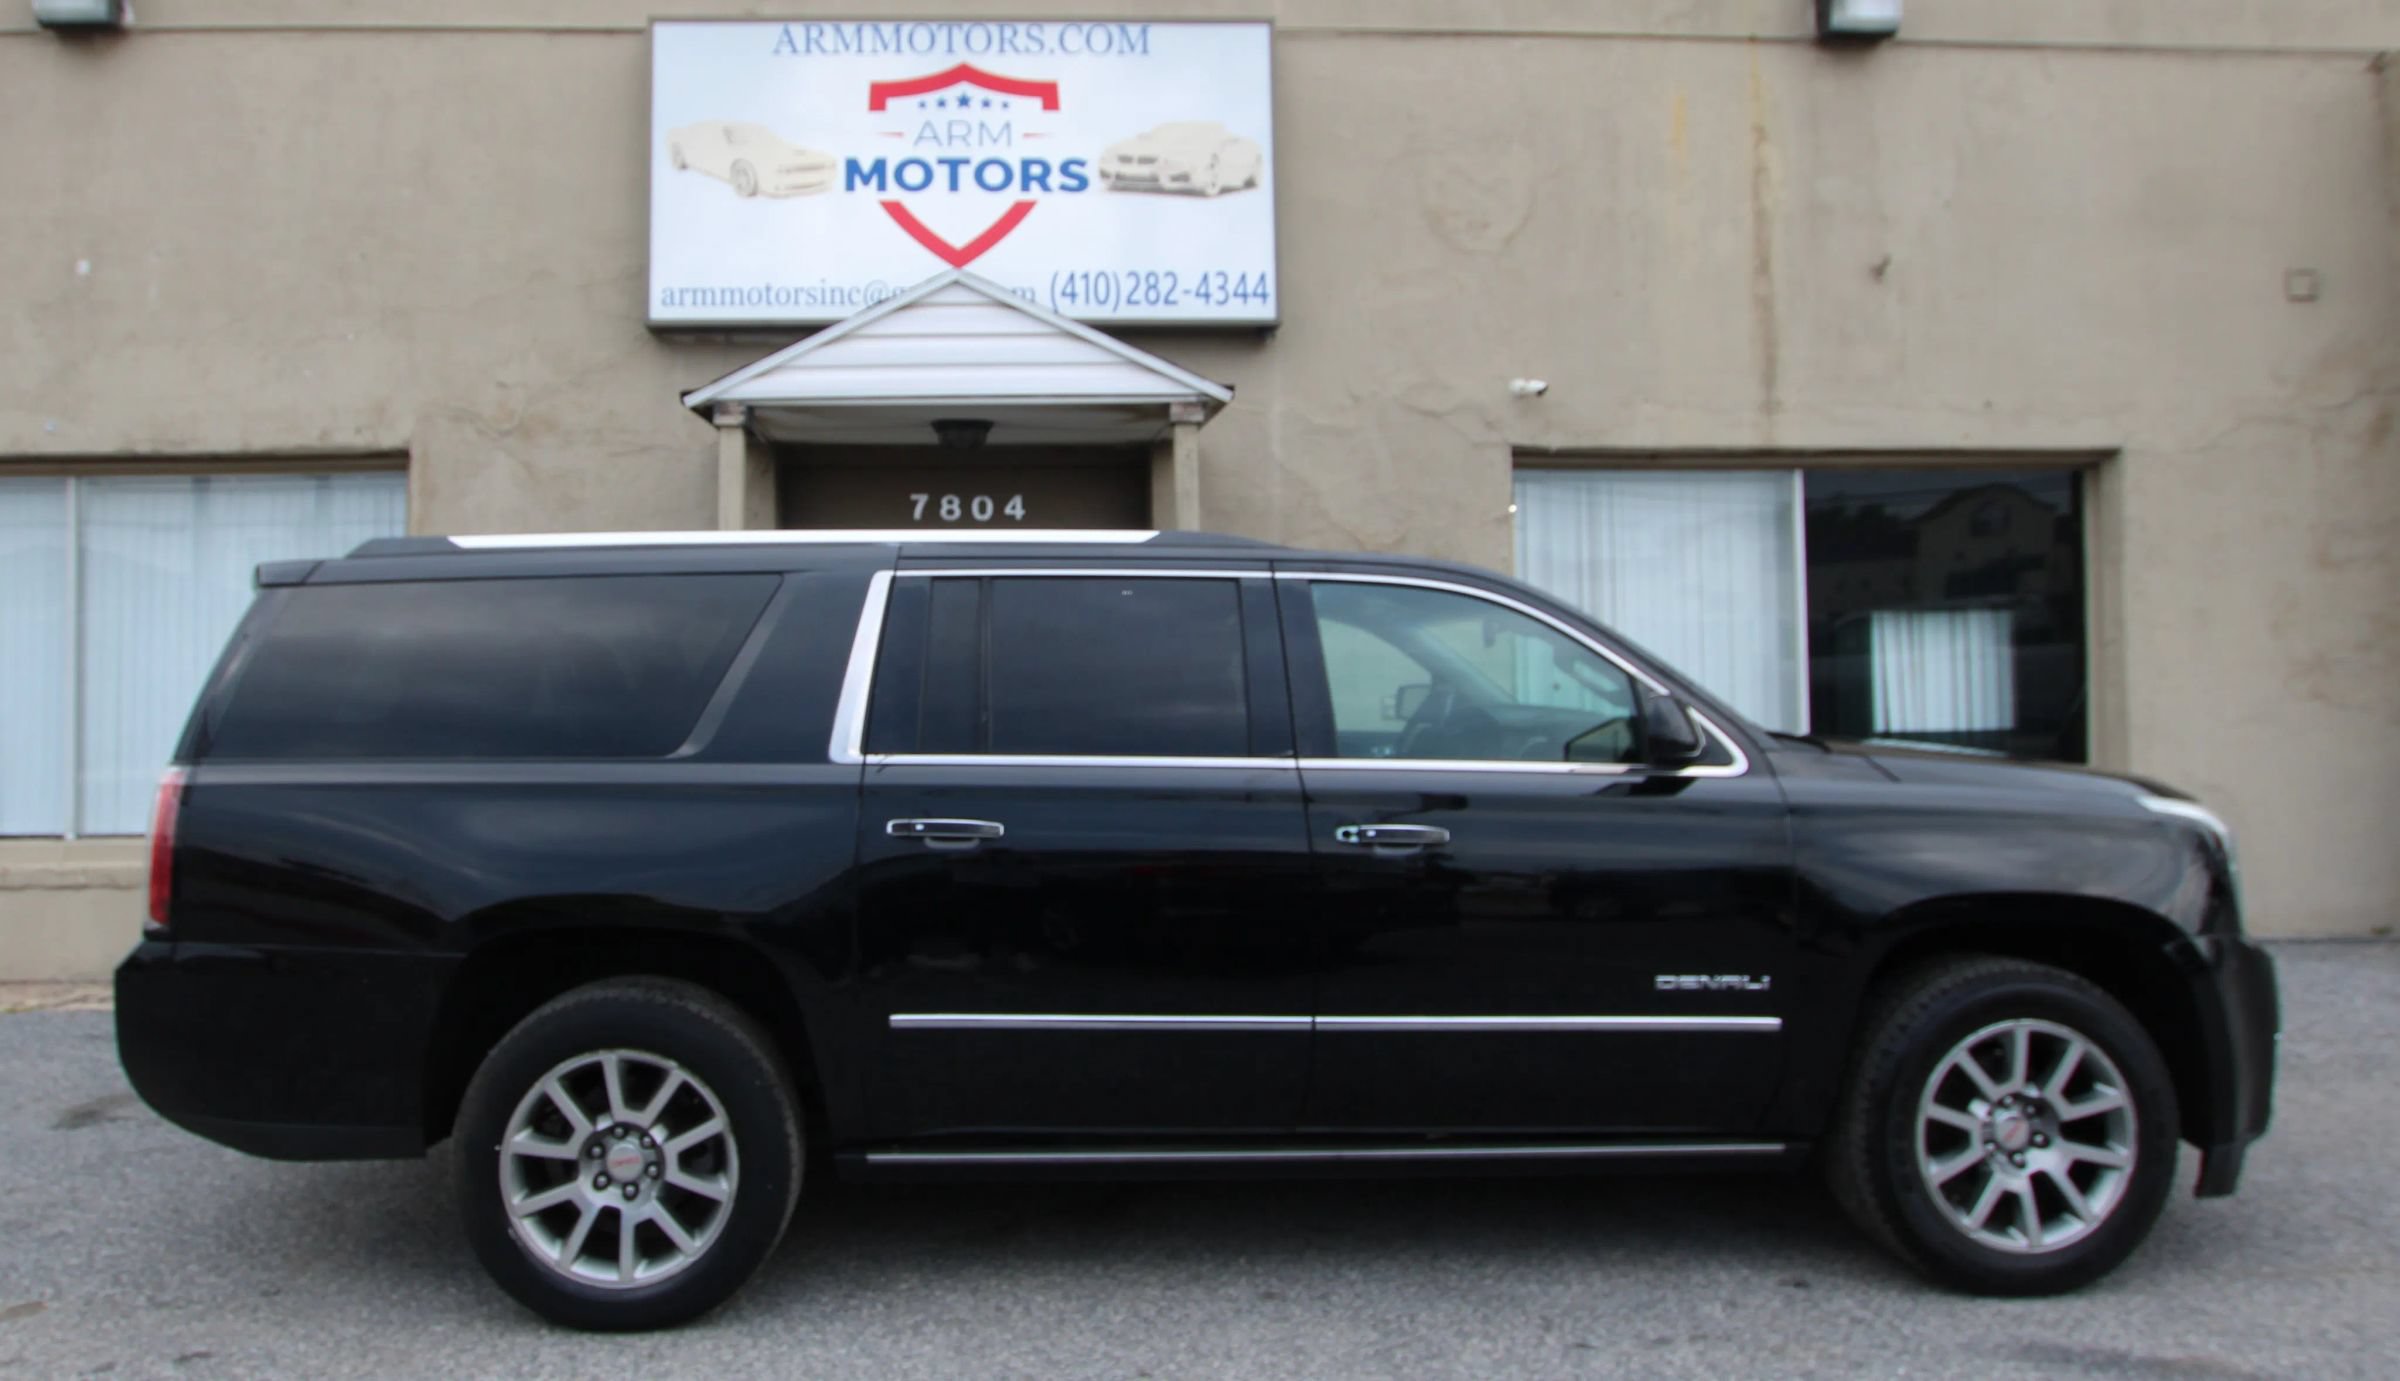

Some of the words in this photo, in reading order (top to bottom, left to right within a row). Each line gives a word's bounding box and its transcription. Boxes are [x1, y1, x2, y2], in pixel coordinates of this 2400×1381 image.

[773, 23, 1150, 55] ARMMOTORS.COM
[913, 120, 1013, 147] ARM
[845, 158, 1089, 192] MOTORS
[1050, 271, 1270, 313] (410)282-4344
[910, 494, 1026, 521] 7804
[1656, 975, 1771, 990] DENALI
